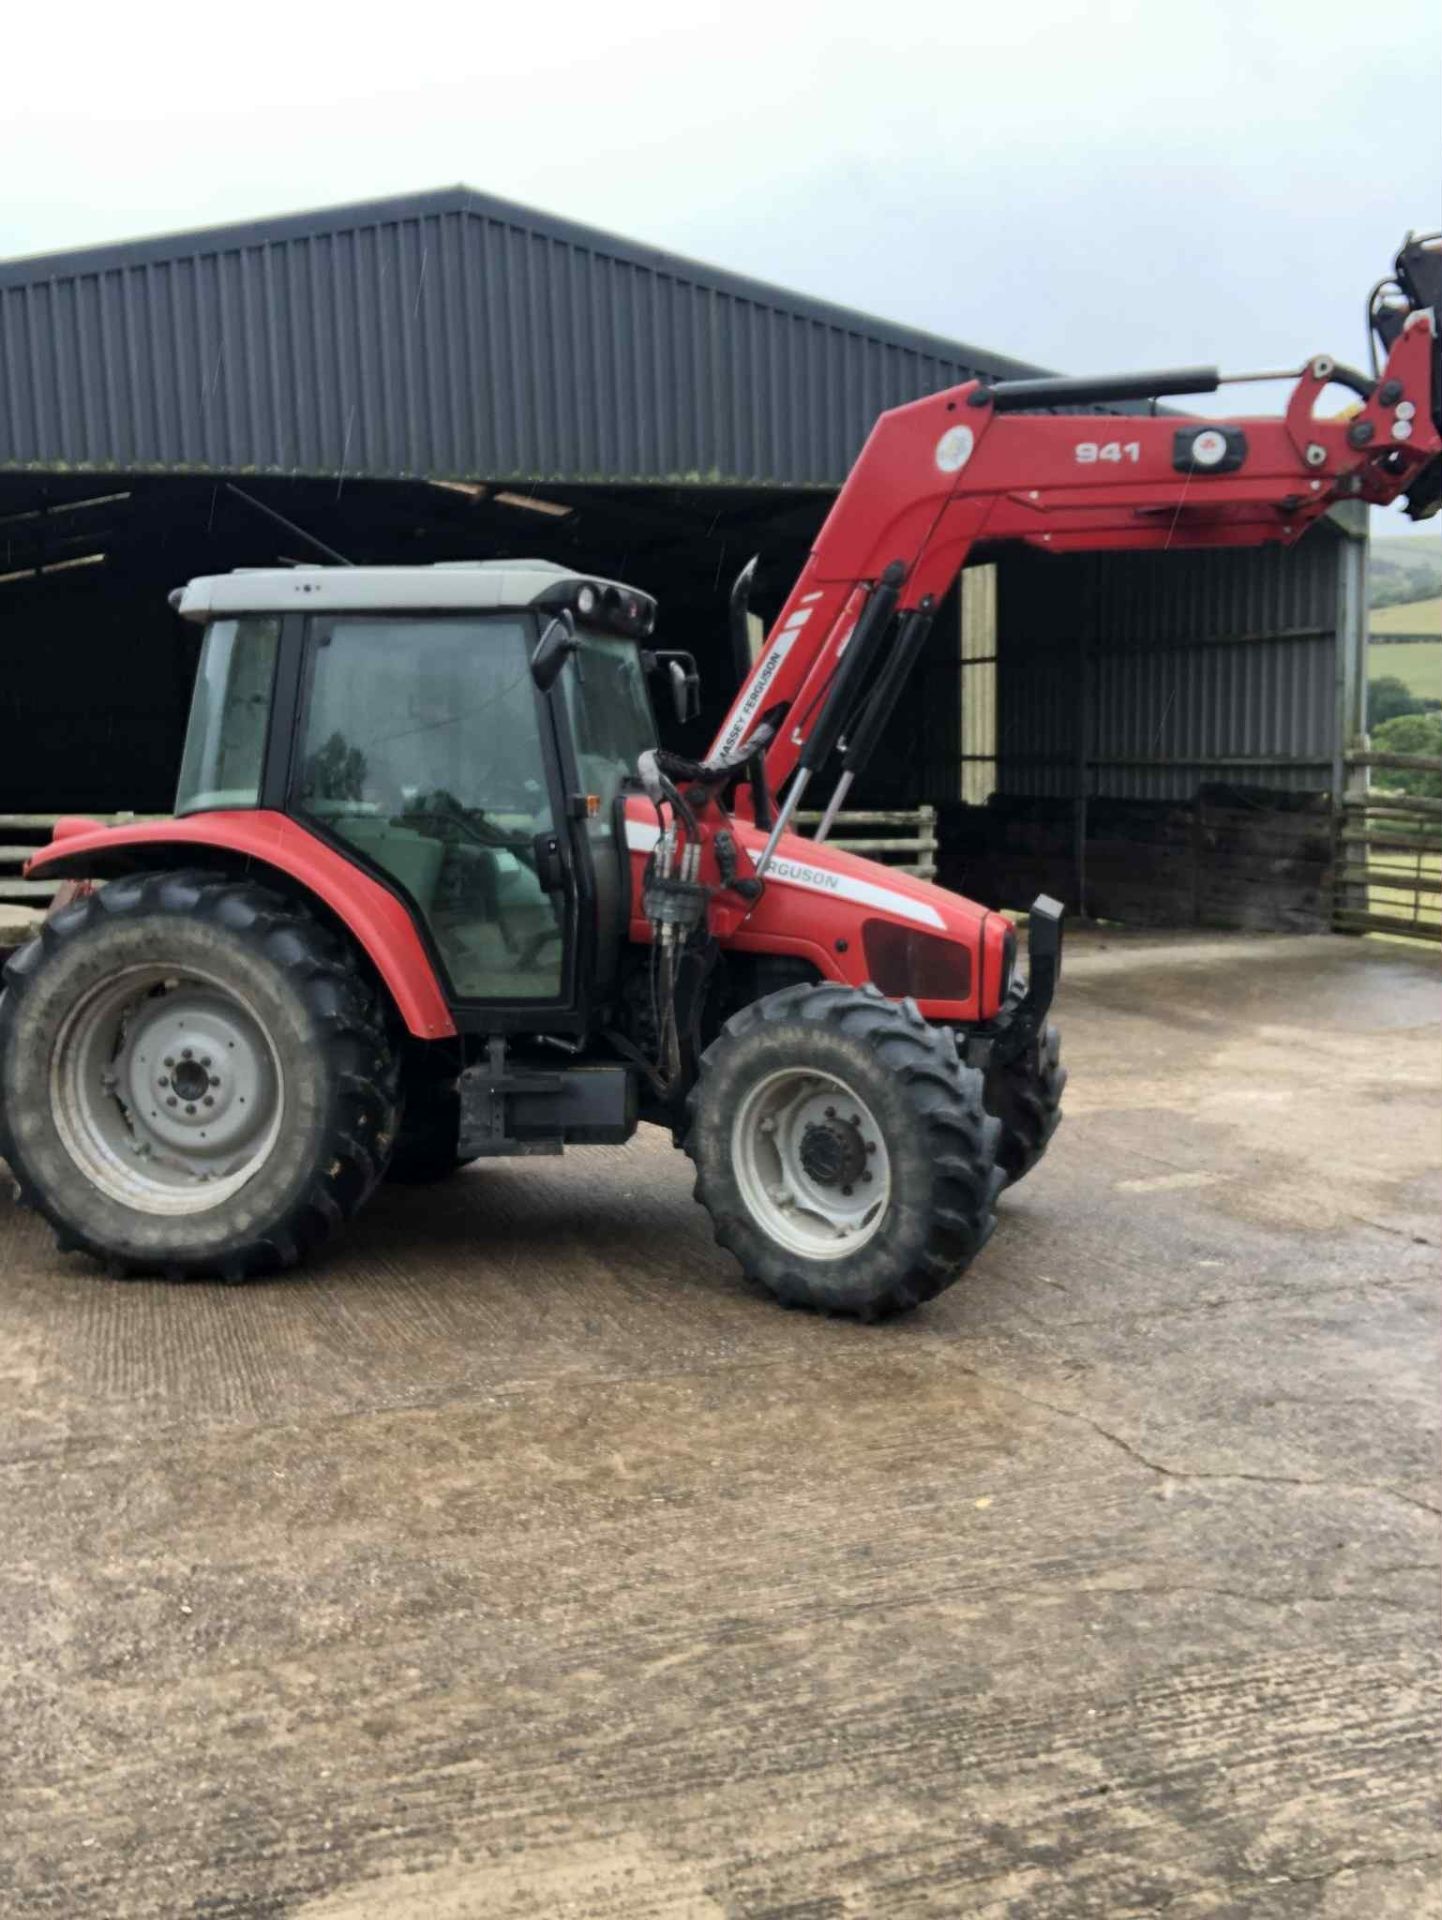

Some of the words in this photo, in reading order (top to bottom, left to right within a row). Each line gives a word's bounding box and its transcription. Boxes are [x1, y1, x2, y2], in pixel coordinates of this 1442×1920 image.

[1075, 441, 1140, 464] 941
[743, 652, 781, 714] FERGUSON
[757, 856, 839, 888] RGUSON
